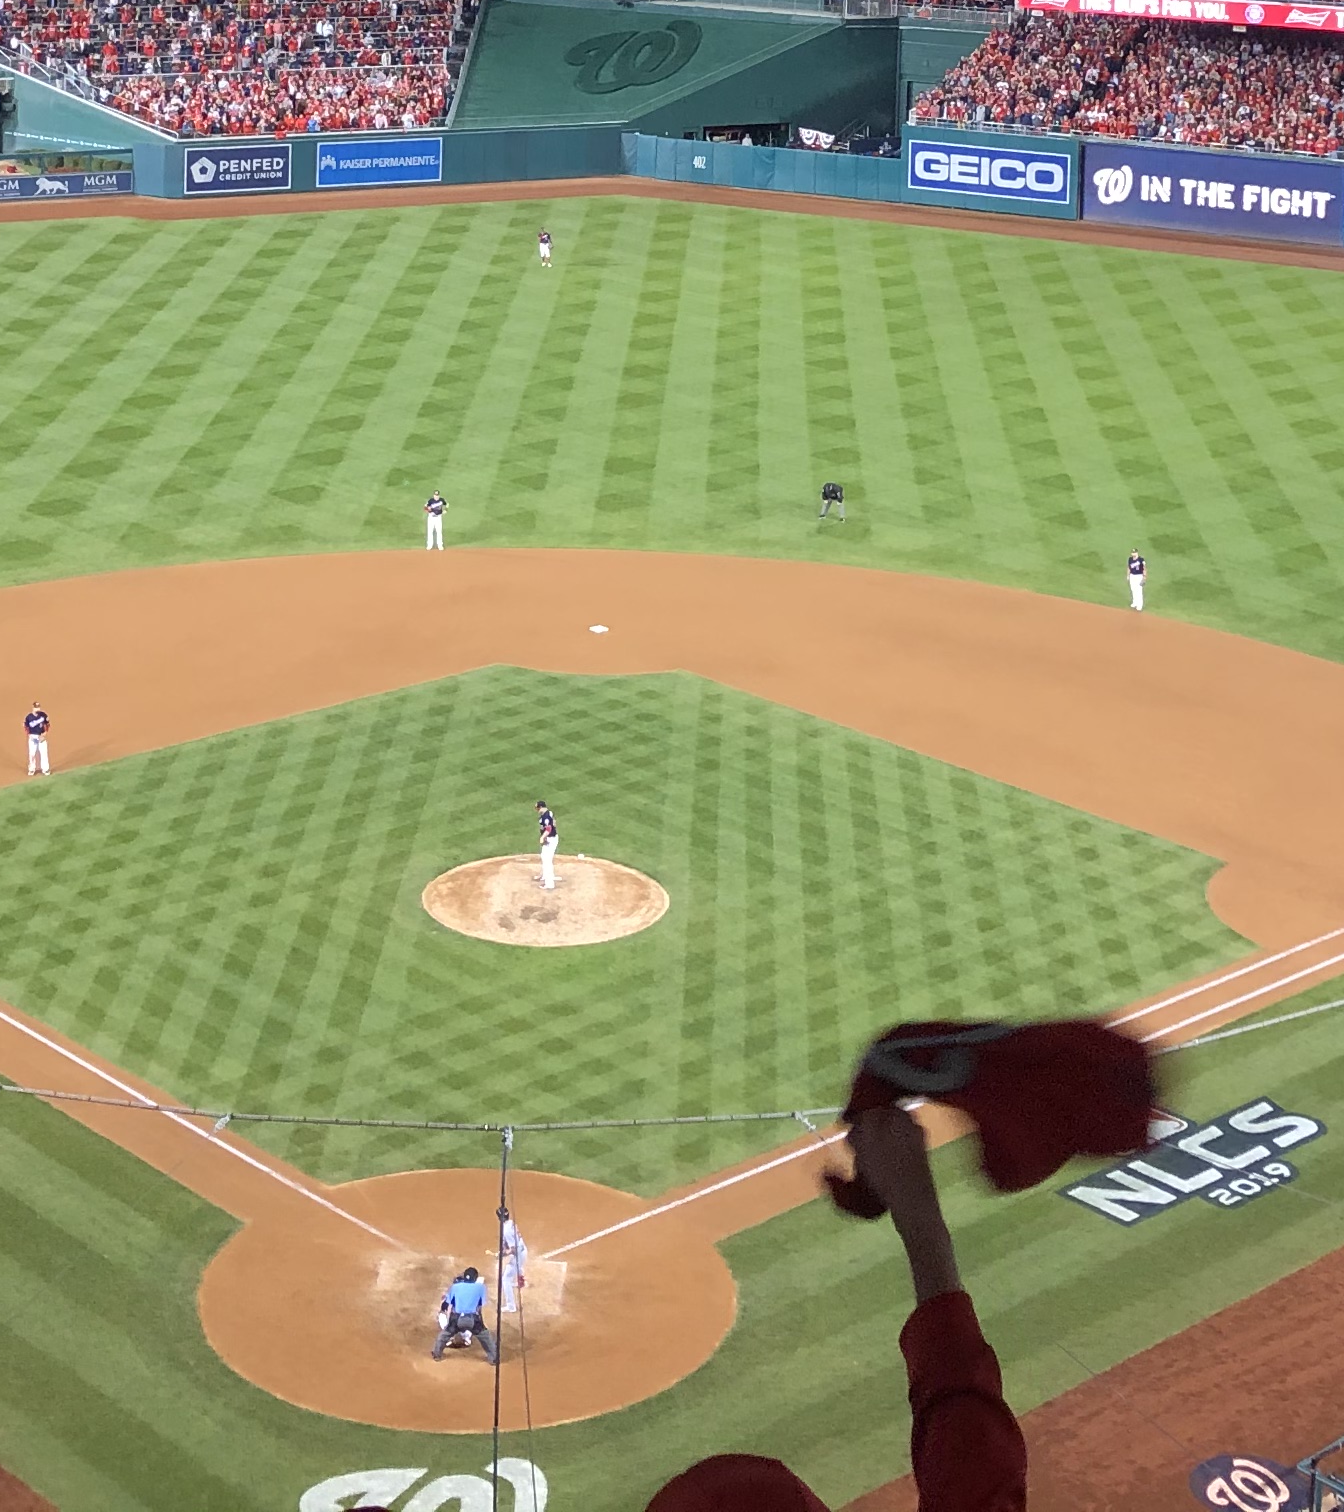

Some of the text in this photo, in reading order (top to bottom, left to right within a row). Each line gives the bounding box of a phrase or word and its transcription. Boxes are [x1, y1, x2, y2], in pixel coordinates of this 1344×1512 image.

[1162, 0, 1192, 16] FOR
[1195, 1, 1230, 20] YOU.
[219, 157, 282, 175] PENFED
[339, 155, 436, 170] KAISER PERMANENTE
[692, 155, 706, 170] 402
[914, 150, 1064, 194] GEICO
[83, 176, 117, 188] MGM
[219, 170, 283, 182] CREDIT UNION
[1140, 175, 1171, 202] IN
[1180, 179, 1235, 210] THE
[1242, 185, 1332, 219] FIGHT
[1067, 1101, 1319, 1222] NLCS
[1208, 1162, 1292, 1206] 2019
